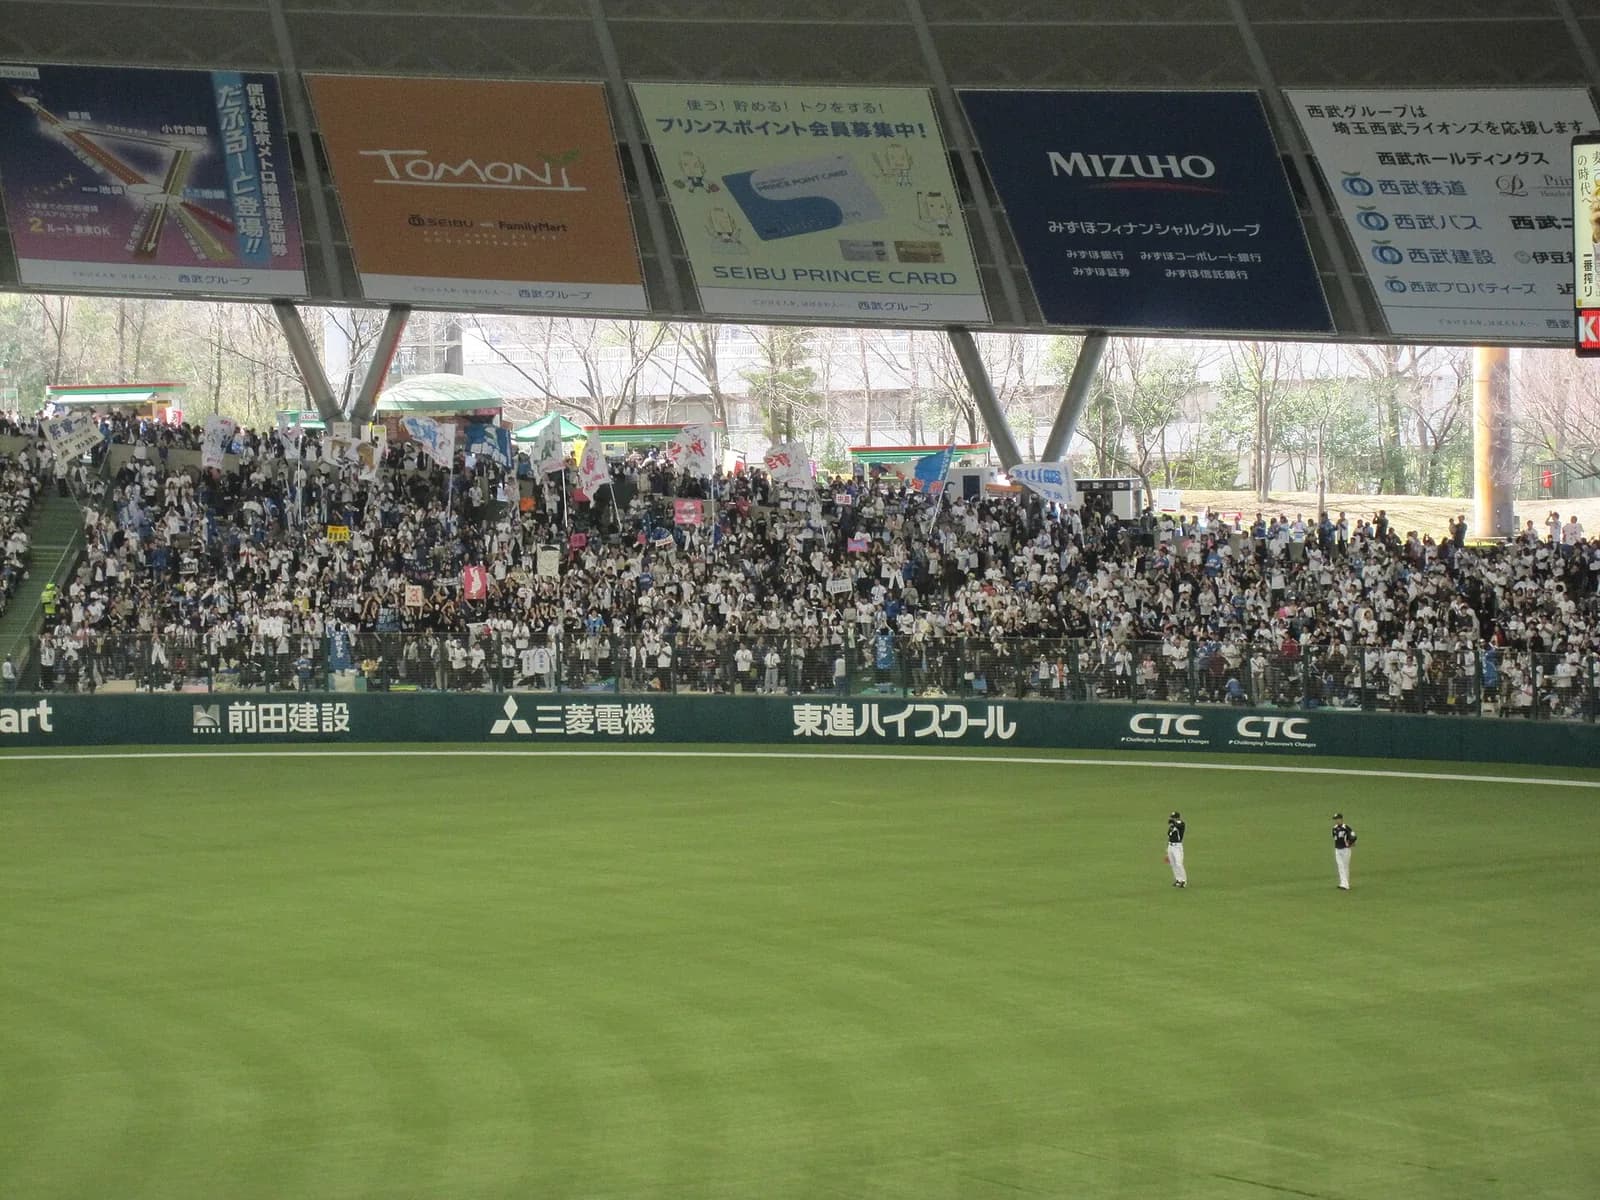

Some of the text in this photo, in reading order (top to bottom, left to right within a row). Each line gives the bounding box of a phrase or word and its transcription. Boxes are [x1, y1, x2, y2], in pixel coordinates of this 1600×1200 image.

[1305, 104, 1427, 119] 西武グループは
[655, 117, 927, 139] プリンスポイント会員募集中!
[1332, 120, 1584, 136] 埼玉西武ライオンズを応援します
[1046, 151, 1216, 178] MIZUHO
[1376, 151, 1550, 166] 西武ホールディングス
[359, 149, 587, 191] TOMONI
[1577, 155, 1593, 203] の時代へ
[1377, 179, 1468, 197] 西武鉄道
[426, 218, 568, 233] SEIBU FamilyMart
[1047, 221, 1261, 236] みずほフィナンシャルグループ
[1392, 214, 1482, 231] 西武バス
[1066, 250, 1262, 264] みずほ銀行 みずほコーポレート銀行
[1407, 248, 1496, 265] 西武建設
[712, 266, 957, 285] SEIBU PRINCE CARD
[1072, 267, 1249, 280] みずほ証券 みずほ信託銀行
[1583, 253, 1593, 297] 一番搾り
[518, 289, 593, 300] 西武グループ
[1410, 281, 1537, 295] 西武プロパティーズ
[858, 301, 932, 312] 西武グループ
[228, 701, 350, 733] 前田建設
[535, 703, 656, 736] 三菱電機
[792, 703, 1017, 740] 東進ハイスクール
[1129, 713, 1203, 736] CTC
[1237, 716, 1311, 739] CTC
